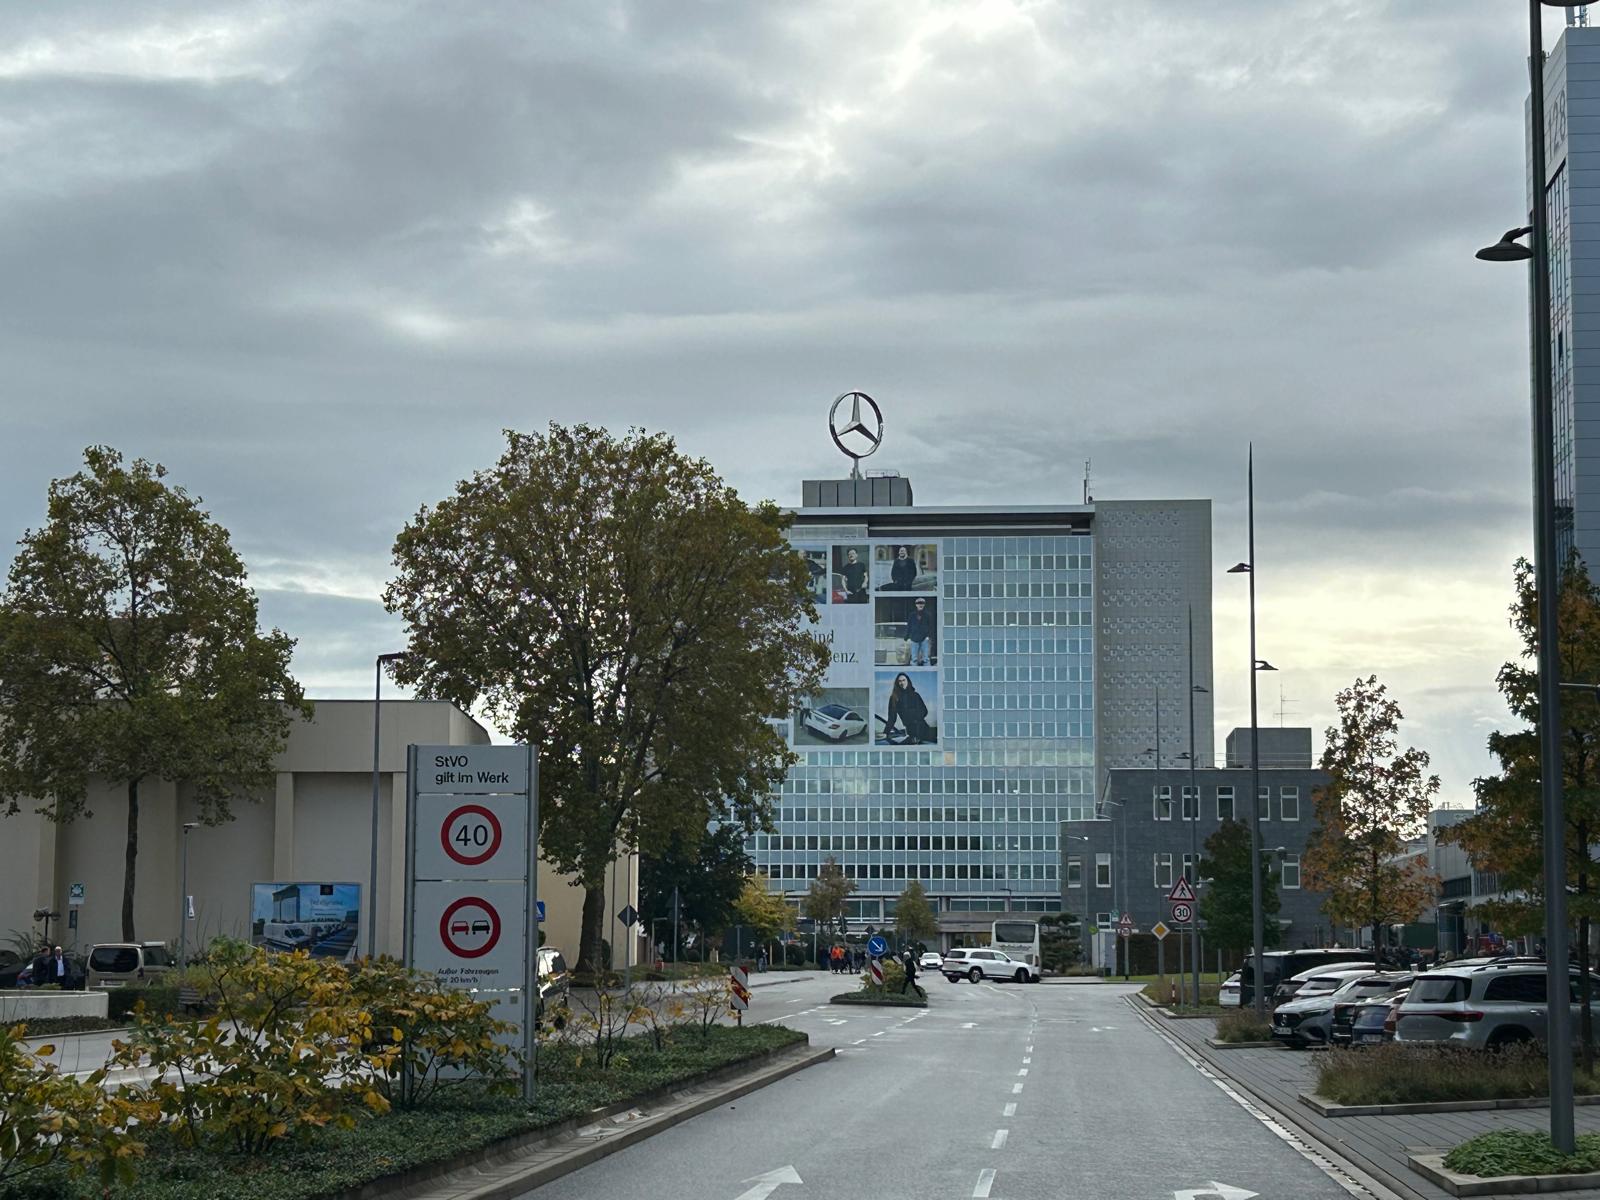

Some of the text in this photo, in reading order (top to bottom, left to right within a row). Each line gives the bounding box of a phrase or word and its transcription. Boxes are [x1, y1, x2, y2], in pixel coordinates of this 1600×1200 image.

[435, 755, 469, 768] StVO
[435, 771, 456, 785] gilt
[477, 771, 510, 783] Werk
[455, 824, 489, 847] 40
[1175, 907, 1189, 918] 30
